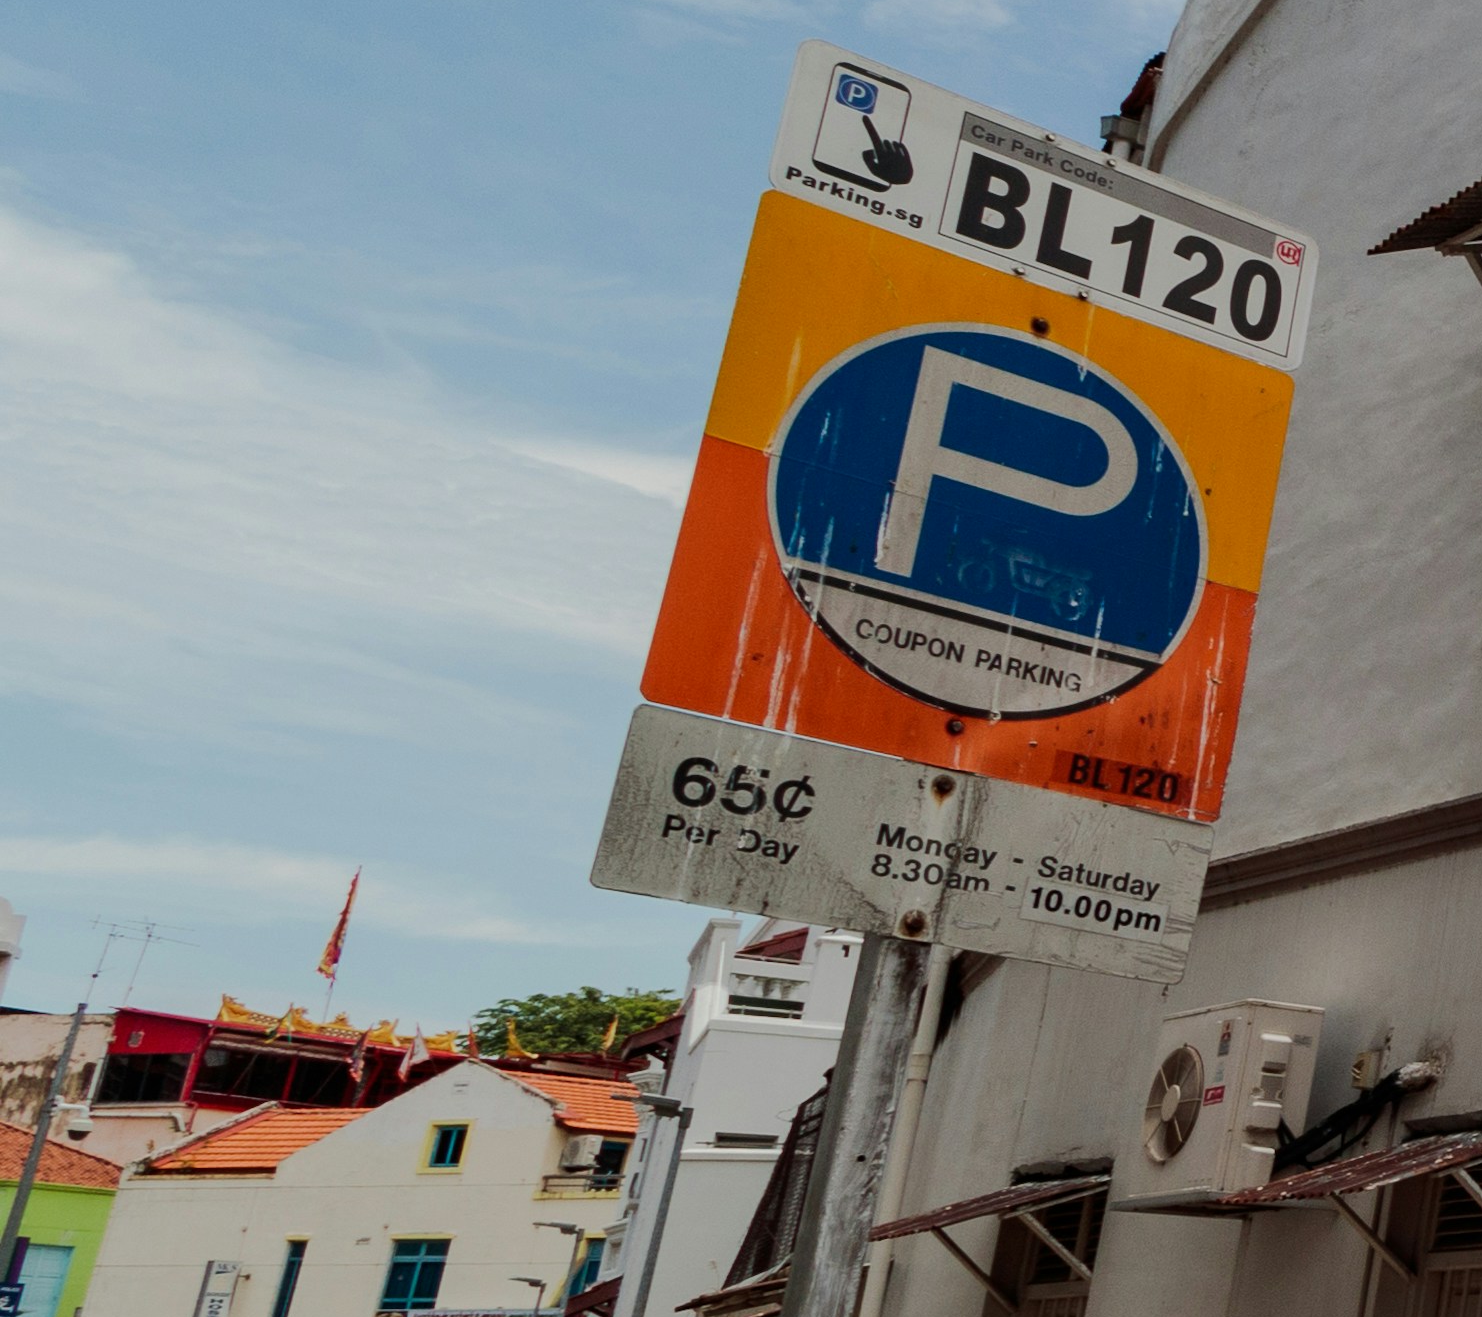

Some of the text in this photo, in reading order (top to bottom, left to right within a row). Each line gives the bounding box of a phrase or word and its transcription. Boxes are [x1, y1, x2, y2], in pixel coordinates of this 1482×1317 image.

[971, 124, 1115, 191] Car Park Code:
[786, 165, 924, 229] Parking.sg
[955, 152, 1283, 342] BL120
[875, 345, 1139, 579] P
[855, 618, 1083, 694] COUPON PARKING
[672, 756, 816, 822] 65¢
[662, 815, 800, 864] Per Day
[876, 823, 998, 869] Monday
[1037, 856, 1160, 900] Saturday
[871, 854, 990, 892] 8.30am
[1029, 887, 1162, 933] 10.00pm
